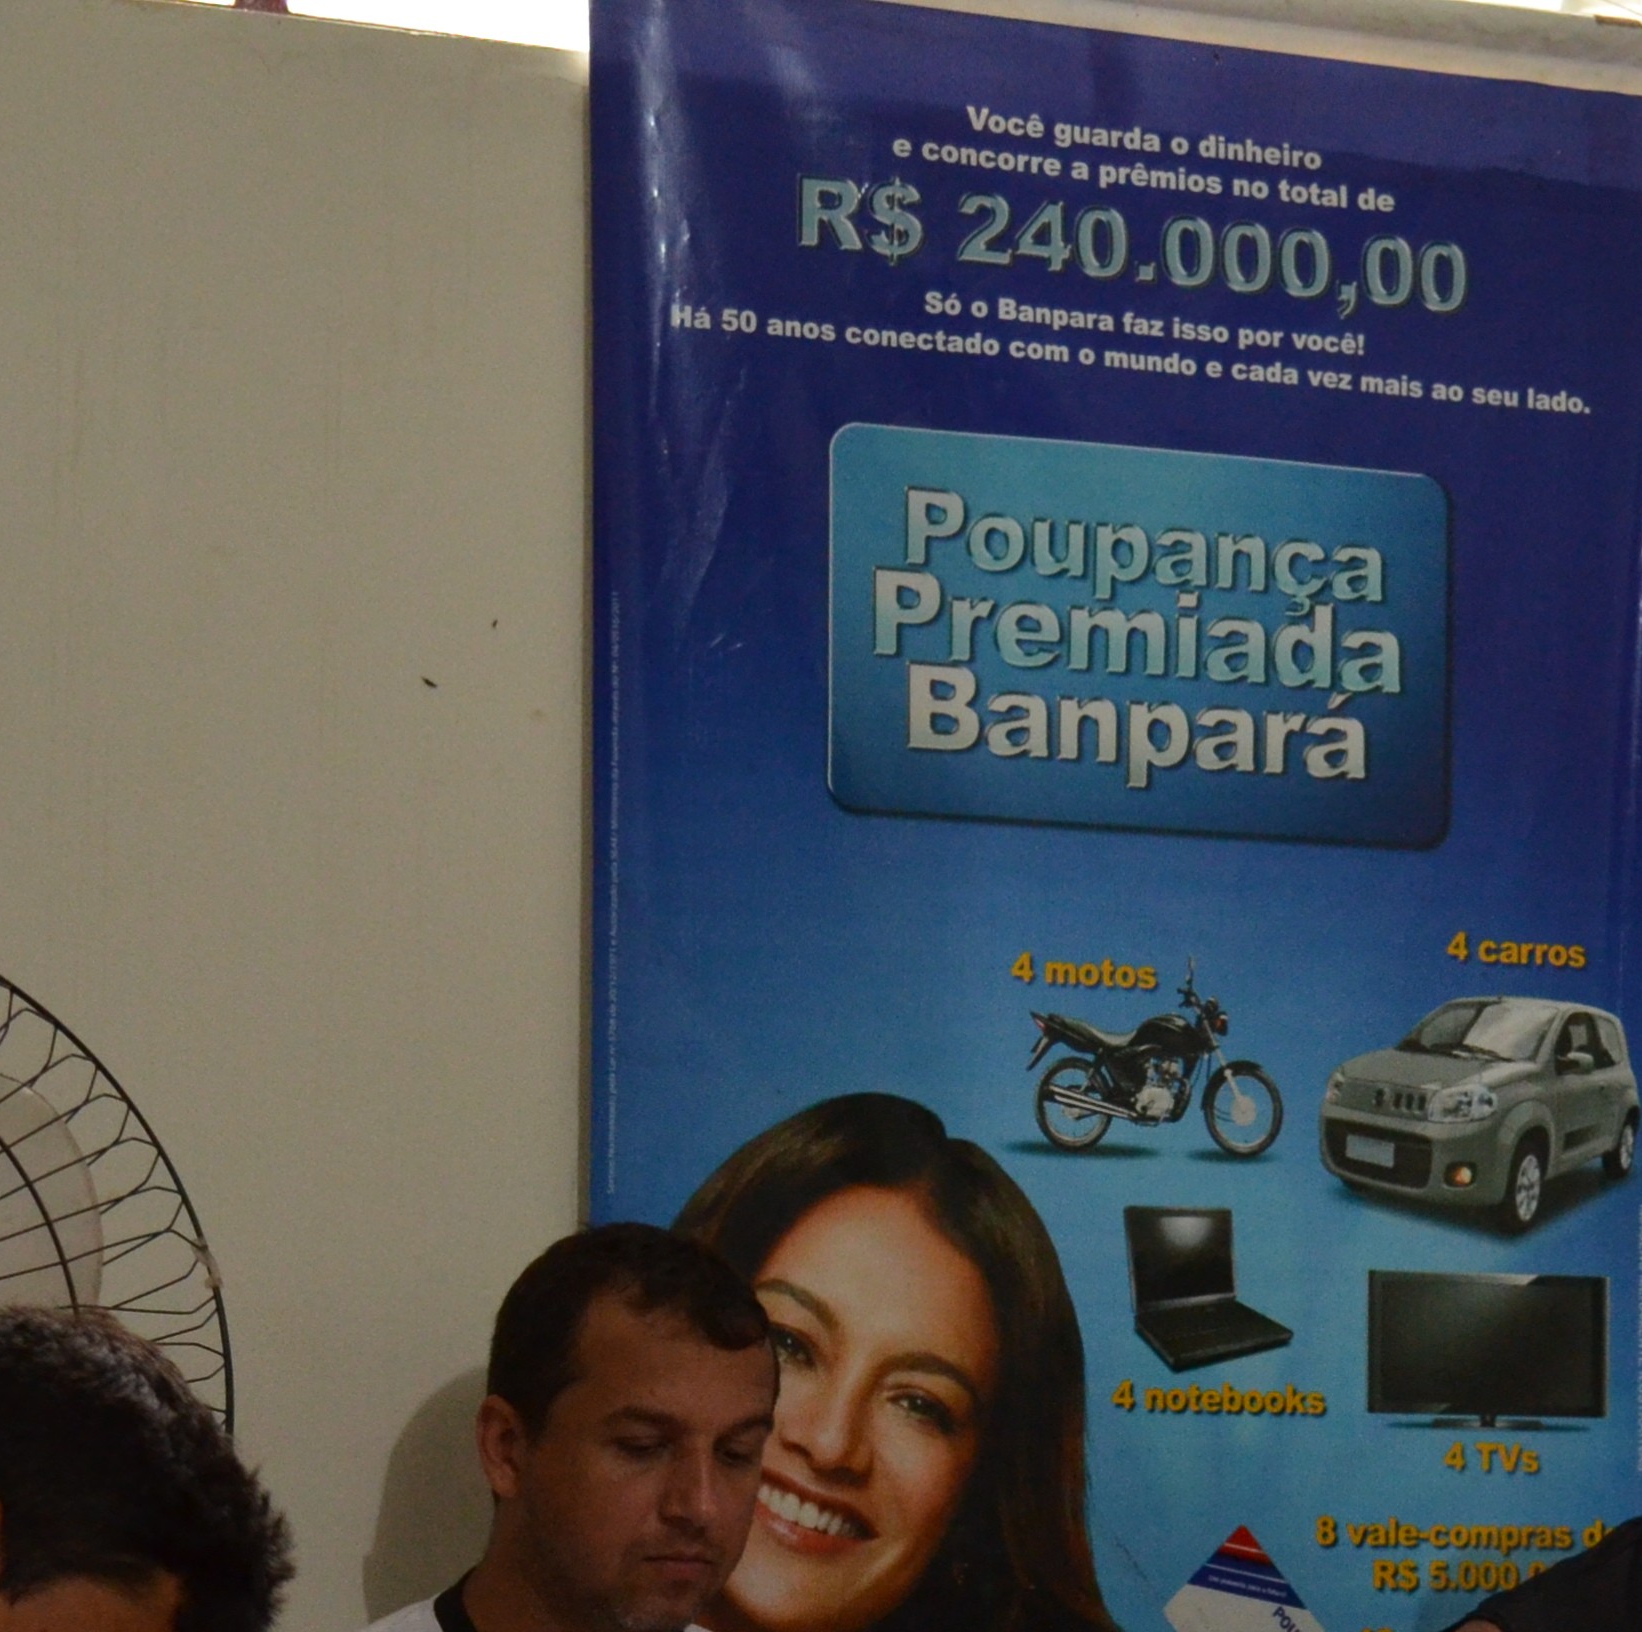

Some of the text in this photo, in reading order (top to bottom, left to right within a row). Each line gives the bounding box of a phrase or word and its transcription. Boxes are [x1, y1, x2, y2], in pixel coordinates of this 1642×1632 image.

[967, 105, 1322, 170] Você guarda o dinheiro
[892, 138, 1396, 212] e concorre a prêmios no total de
[798, 175, 1468, 319] R$ 240.000,00
[924, 290, 1365, 356] Só o Banpara faz isso por você!
[671, 305, 1591, 414] Há 50 anos conectado com o mundo e cada vez mais ao seu lado.
[905, 485, 1384, 616] Poupança
[872, 565, 1401, 694] Premiada
[907, 661, 1368, 788] Banpará
[1010, 953, 1158, 990] 4 motos
[1446, 934, 1587, 968] 4 carros
[1112, 1379, 1327, 1416] 4 notebooks
[1444, 1442, 1541, 1474] 4 TVs
[1317, 1516, 1337, 1547] 8
[1346, 1517, 1574, 1554] vale-compras
[1373, 1560, 1419, 1592] R$
